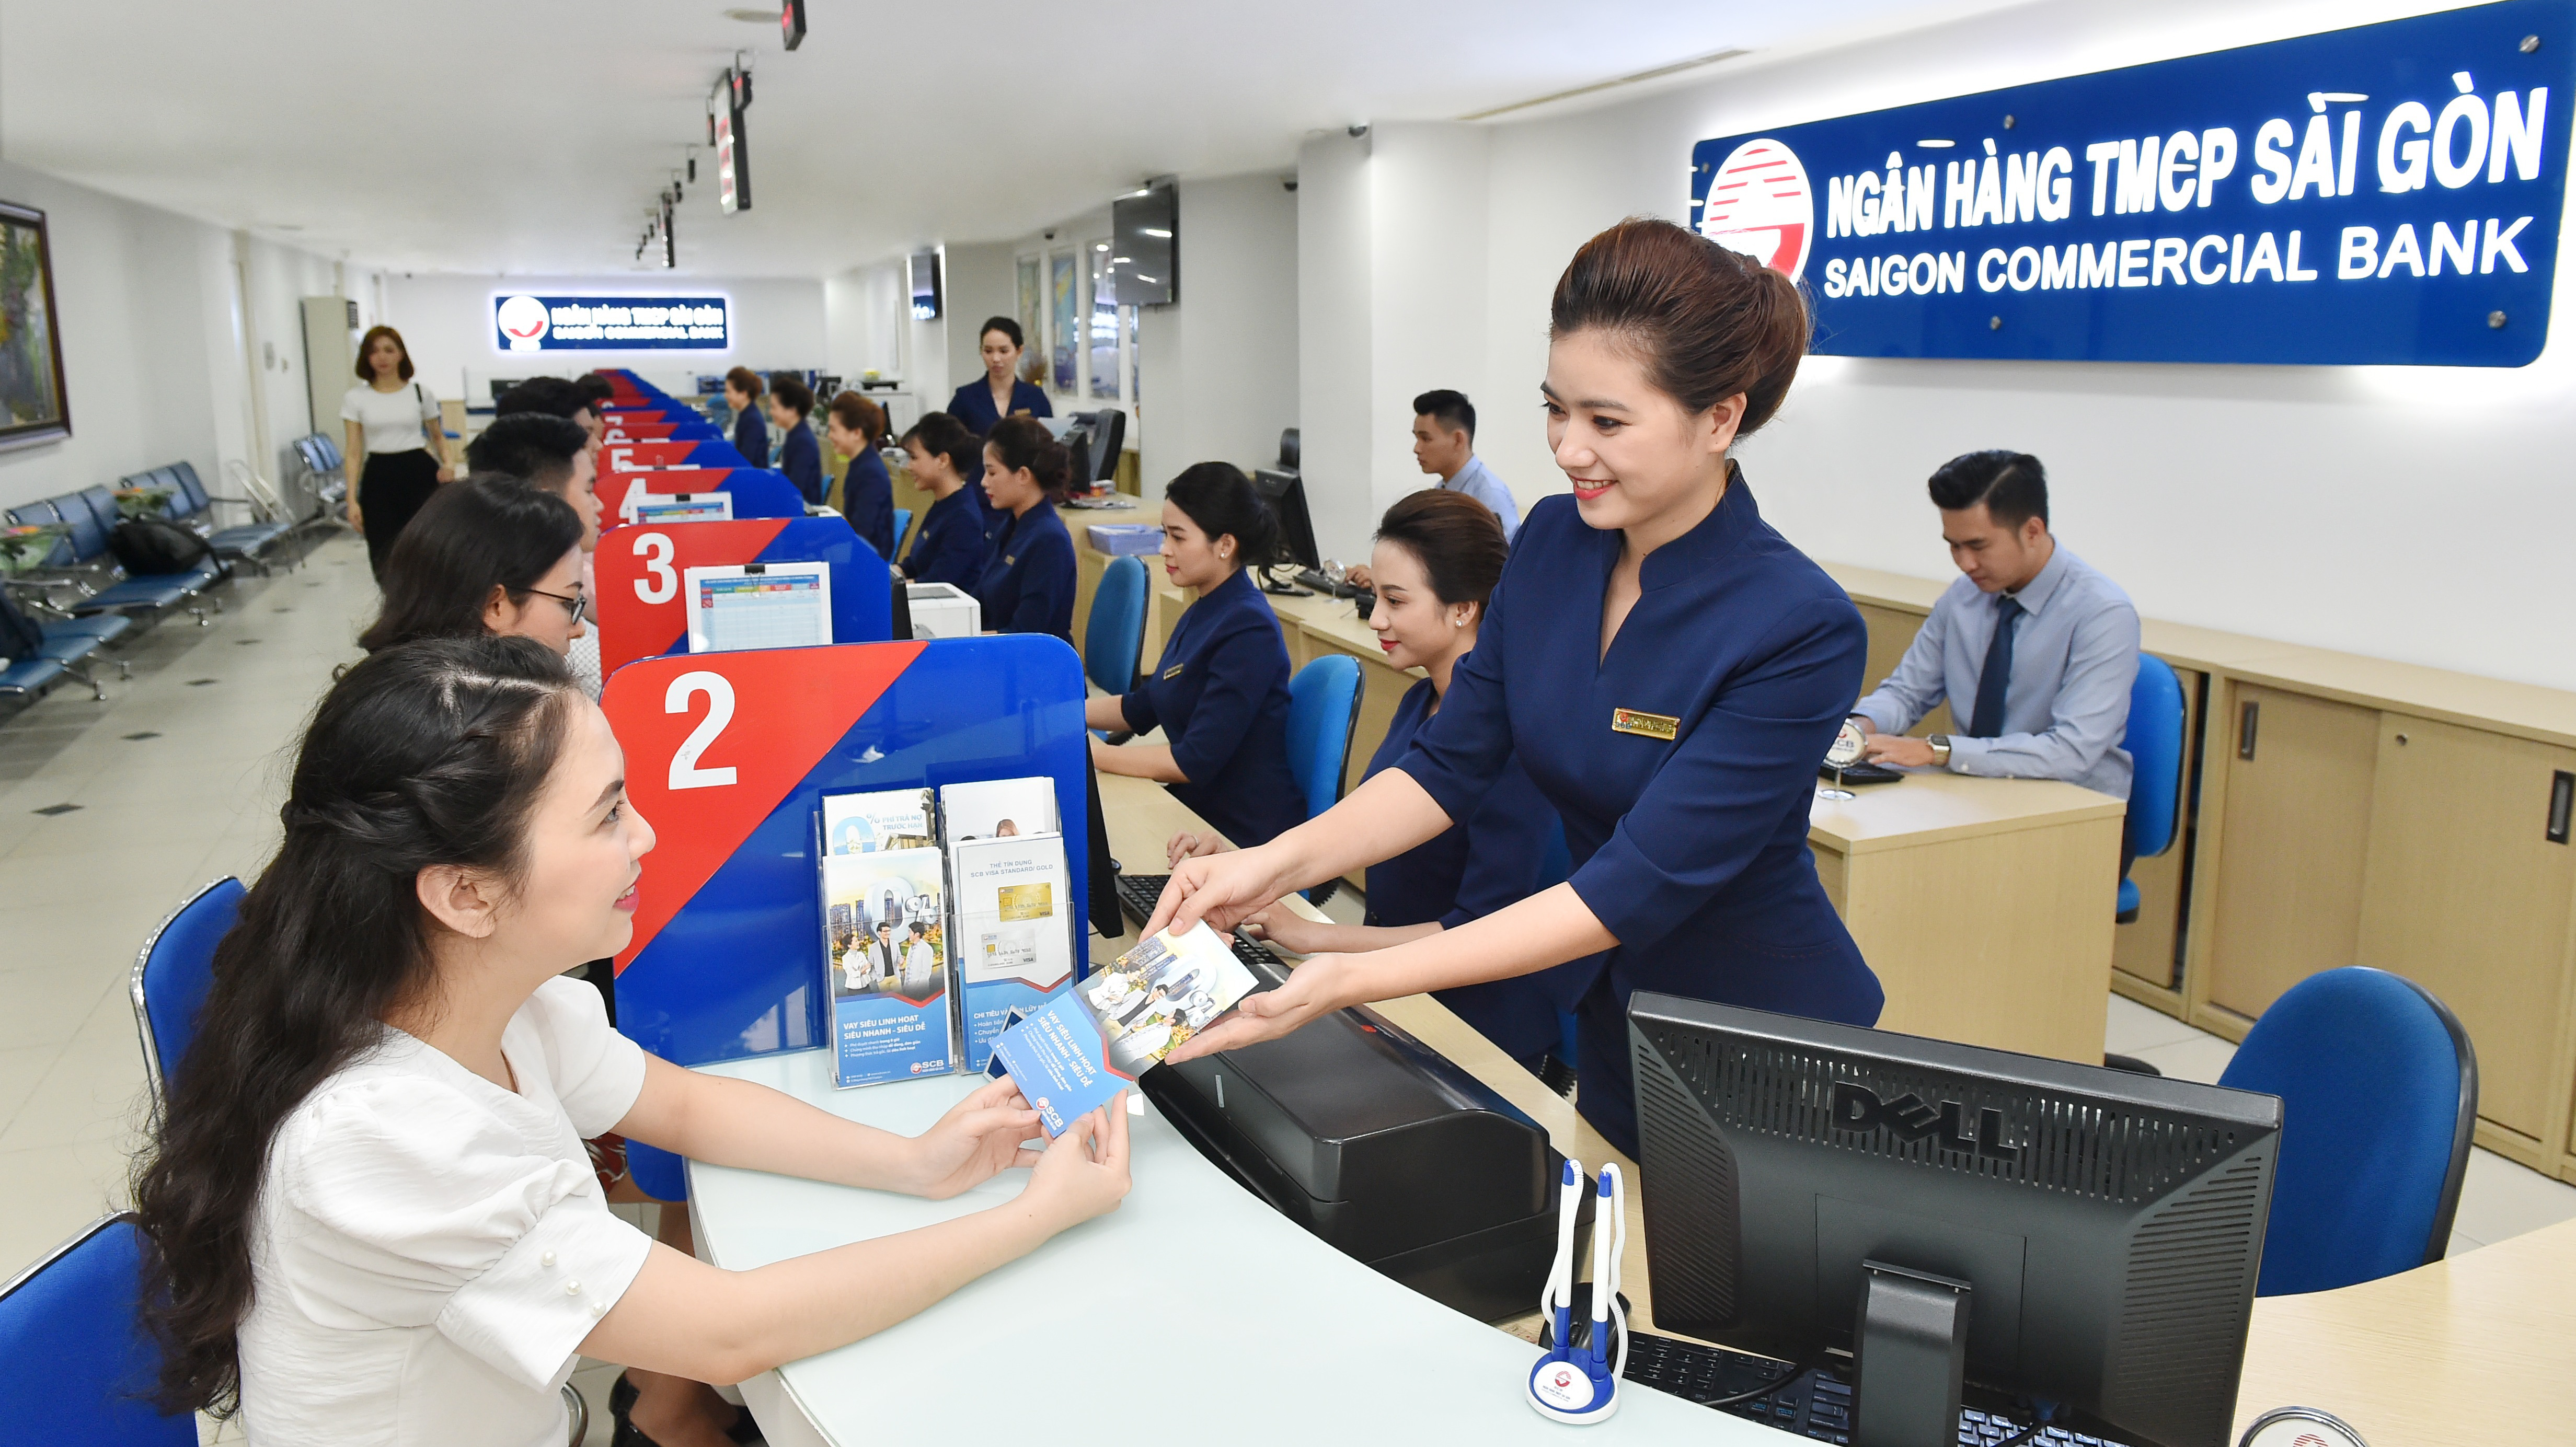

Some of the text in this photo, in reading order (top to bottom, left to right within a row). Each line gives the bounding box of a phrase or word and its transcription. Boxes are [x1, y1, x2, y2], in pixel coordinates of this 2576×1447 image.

[1826, 151, 1936, 239] NGÂN
[1944, 137, 2073, 229] HÀNG
[2250, 92, 2362, 205] SÀI
[2377, 71, 2548, 194] GÒN
[1823, 216, 2534, 299] SAIGON COMMERCIAL BANK
[632, 533, 678, 604] 3
[665, 671, 737, 790] 2
[843, 1015, 919, 1030] VAY SIÊU LINH HOẠT
[844, 1031, 861, 1040] SIÊU
[862, 1027, 891, 1038] NHANH
[897, 1024, 914, 1033] SIÊU
[1038, 1016, 1052, 1033] SIÊU
[1049, 1032, 1070, 1058] NHANH
[1069, 1061, 1084, 1077] SIÊU
[1048, 1010, 1096, 1074] VAY SIÊU LINH HOẠT
[922, 1059, 944, 1069] SCB
[1046, 1106, 1063, 1127] SCB
[1831, 1080, 2019, 1163] DELL
